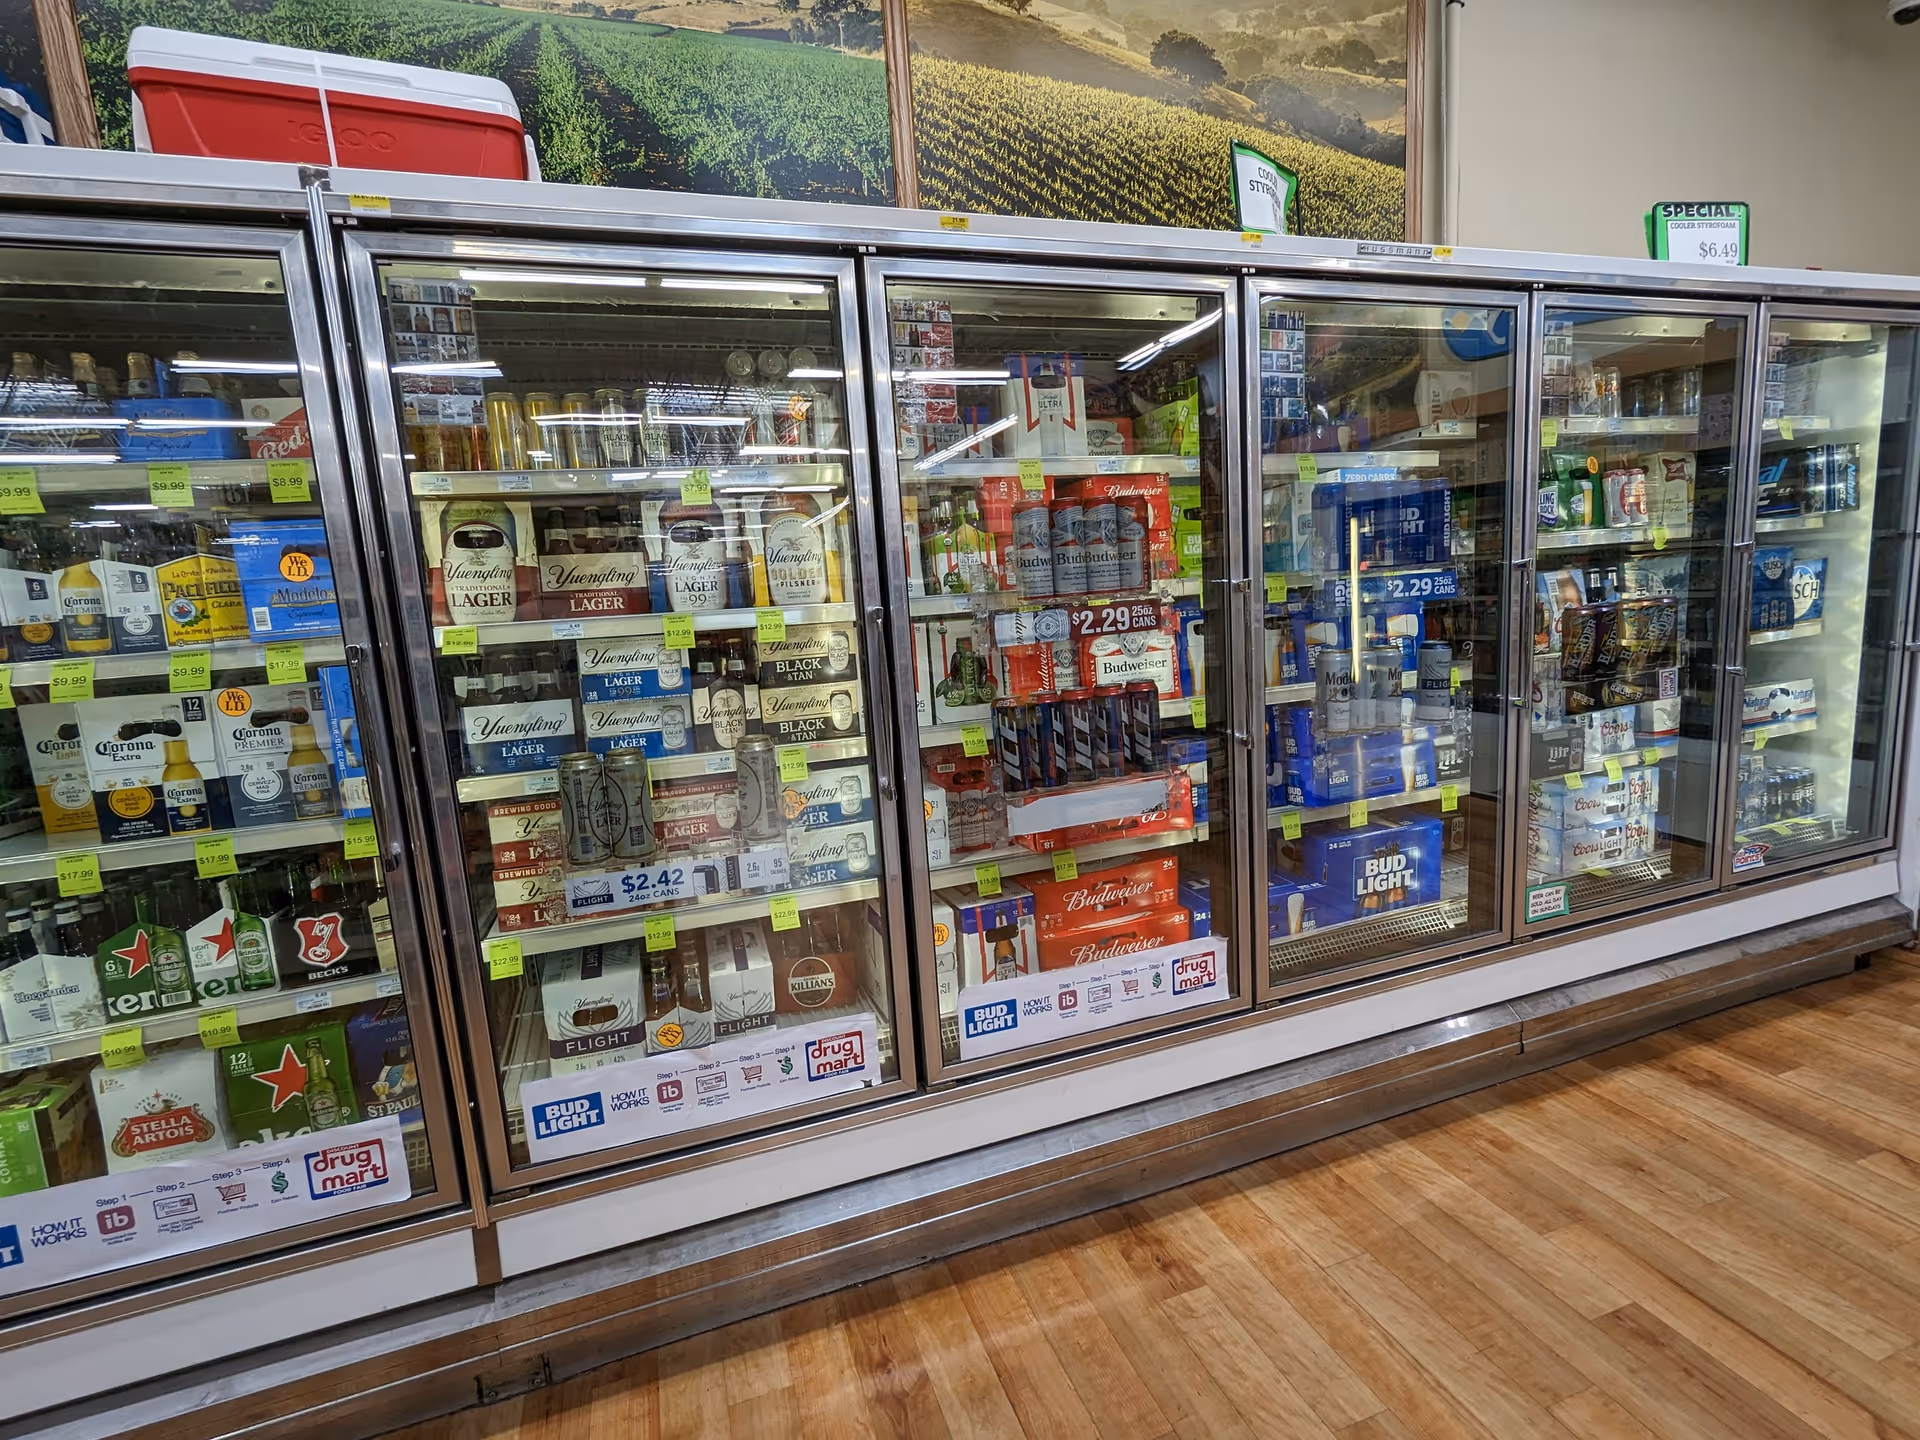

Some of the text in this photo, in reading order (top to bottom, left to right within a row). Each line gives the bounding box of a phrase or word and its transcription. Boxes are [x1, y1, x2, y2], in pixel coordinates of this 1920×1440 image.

[289, 119, 399, 153] IGLOO
[1699, 241, 1738, 259] $6.49
[1038, 400, 1063, 408] ULTRA
[272, 477, 303, 487] $8.99
[1022, 473, 1041, 481] $15.99
[152, 481, 185, 491] $9.99
[683, 482, 708, 493] $7.99
[1103, 484, 1163, 498] Budweiser
[1443, 524, 1451, 547] BUD
[288, 552, 307, 566] We
[763, 547, 823, 565] Yuengling
[286, 564, 310, 577] I.D.
[662, 555, 725, 574] Yuengling
[1763, 560, 1784, 571] BUSCH
[443, 560, 513, 584] Yuengling
[546, 564, 638, 588] Yuengling
[674, 580, 719, 593] LAGER
[780, 579, 816, 588] PILSNER
[1387, 578, 1432, 598] $2.29
[1434, 577, 1452, 586] 25oz
[277, 587, 329, 602] Modelo
[455, 585, 507, 593] TRADITIONAL
[574, 591, 620, 600] TRADITIONAL
[1434, 584, 1455, 595] CANS
[451, 593, 512, 608] LAGER
[569, 598, 625, 612] LAGER
[1132, 605, 1153, 617] 25oz
[759, 622, 783, 632] $12.99
[1072, 605, 1131, 635] $2.29
[1132, 615, 1157, 629] CANS
[667, 629, 692, 638] $12.99
[269, 660, 299, 670] $17.99
[583, 647, 657, 674] Yuengling
[775, 658, 821, 673] BLACK
[1102, 658, 1167, 675] Budweiser
[173, 666, 205, 677] $9.99
[52, 676, 87, 687] $9.99
[604, 675, 643, 687] LAGER
[225, 691, 244, 702] We
[186, 698, 200, 711] 12
[225, 700, 247, 712] I.D.
[698, 702, 758, 721] Yuengling
[765, 697, 831, 716] Yuengling
[473, 712, 567, 738] Yuengling
[589, 711, 660, 732] Yuengling
[714, 718, 744, 730] BLACK
[779, 719, 826, 734] BLACK
[232, 727, 282, 741] Corona
[1601, 721, 1629, 737] Coors
[234, 737, 285, 749] PREMIER
[610, 737, 647, 748] LAGER
[964, 738, 985, 747] $15.99
[1603, 734, 1625, 746] LIGHT
[95, 739, 156, 757] Corona
[501, 744, 545, 756] LAGER
[1548, 747, 1570, 762] Lite
[111, 752, 142, 762] Extra
[781, 762, 804, 771] $12.99
[293, 772, 329, 784] Corona
[1329, 775, 1349, 785] LIGHT
[1415, 779, 1429, 787] LIGHT
[167, 787, 203, 799] Corona
[493, 803, 556, 816] BREWING GOOD
[1574, 798, 1601, 812] Coors
[663, 822, 710, 840] LAGER
[346, 836, 375, 846] $15.99
[1572, 839, 1623, 857] Coors LIGHT
[199, 854, 229, 864] $17.99
[1365, 854, 1407, 876] BUD
[1056, 863, 1074, 871] $17.99
[60, 870, 94, 880] $17.99
[621, 868, 685, 893] $2.42
[979, 877, 998, 885] $15.99
[1356, 869, 1414, 895] LIGHT
[577, 894, 610, 904] FLIGHT
[629, 887, 680, 902] 24oz CANS
[1063, 880, 1154, 911] Budweiser
[773, 911, 796, 920] $22.99
[647, 931, 671, 940] $12.99
[1070, 935, 1164, 965] Budweiser
[492, 957, 519, 967] $22.99
[1175, 957, 1209, 975] drug
[308, 966, 349, 980] BECK'S
[791, 977, 834, 991] KILLIAN'S
[1179, 972, 1216, 990] mart
[14, 984, 80, 1003] Hoegaarden
[573, 995, 614, 1009] Yuengling
[973, 1002, 1008, 1021] BUD
[1022, 1003, 1053, 1016] WORKS
[201, 1026, 232, 1037] $10.99
[719, 1015, 770, 1034] FLIGHT
[968, 1014, 1015, 1035] LIGHT
[566, 1032, 630, 1054] FLIGHT
[104, 1045, 136, 1056] $10.99
[811, 1040, 854, 1061] drug
[229, 1052, 247, 1065] 12
[816, 1053, 862, 1074] mart
[611, 1088, 648, 1103] HOW IT
[661, 1085, 679, 1099] ib
[545, 1099, 590, 1121] BUD
[610, 1097, 650, 1111] WORKS
[130, 1114, 191, 1137] STELLA
[539, 1109, 600, 1135] LIGHT
[132, 1126, 194, 1147] ARTOIS
[313, 1149, 372, 1174] drug
[321, 1164, 388, 1191] mart
[32, 1217, 82, 1236] HOW IT
[104, 1211, 129, 1229] ib
[31, 1227, 87, 1248] WORKS
